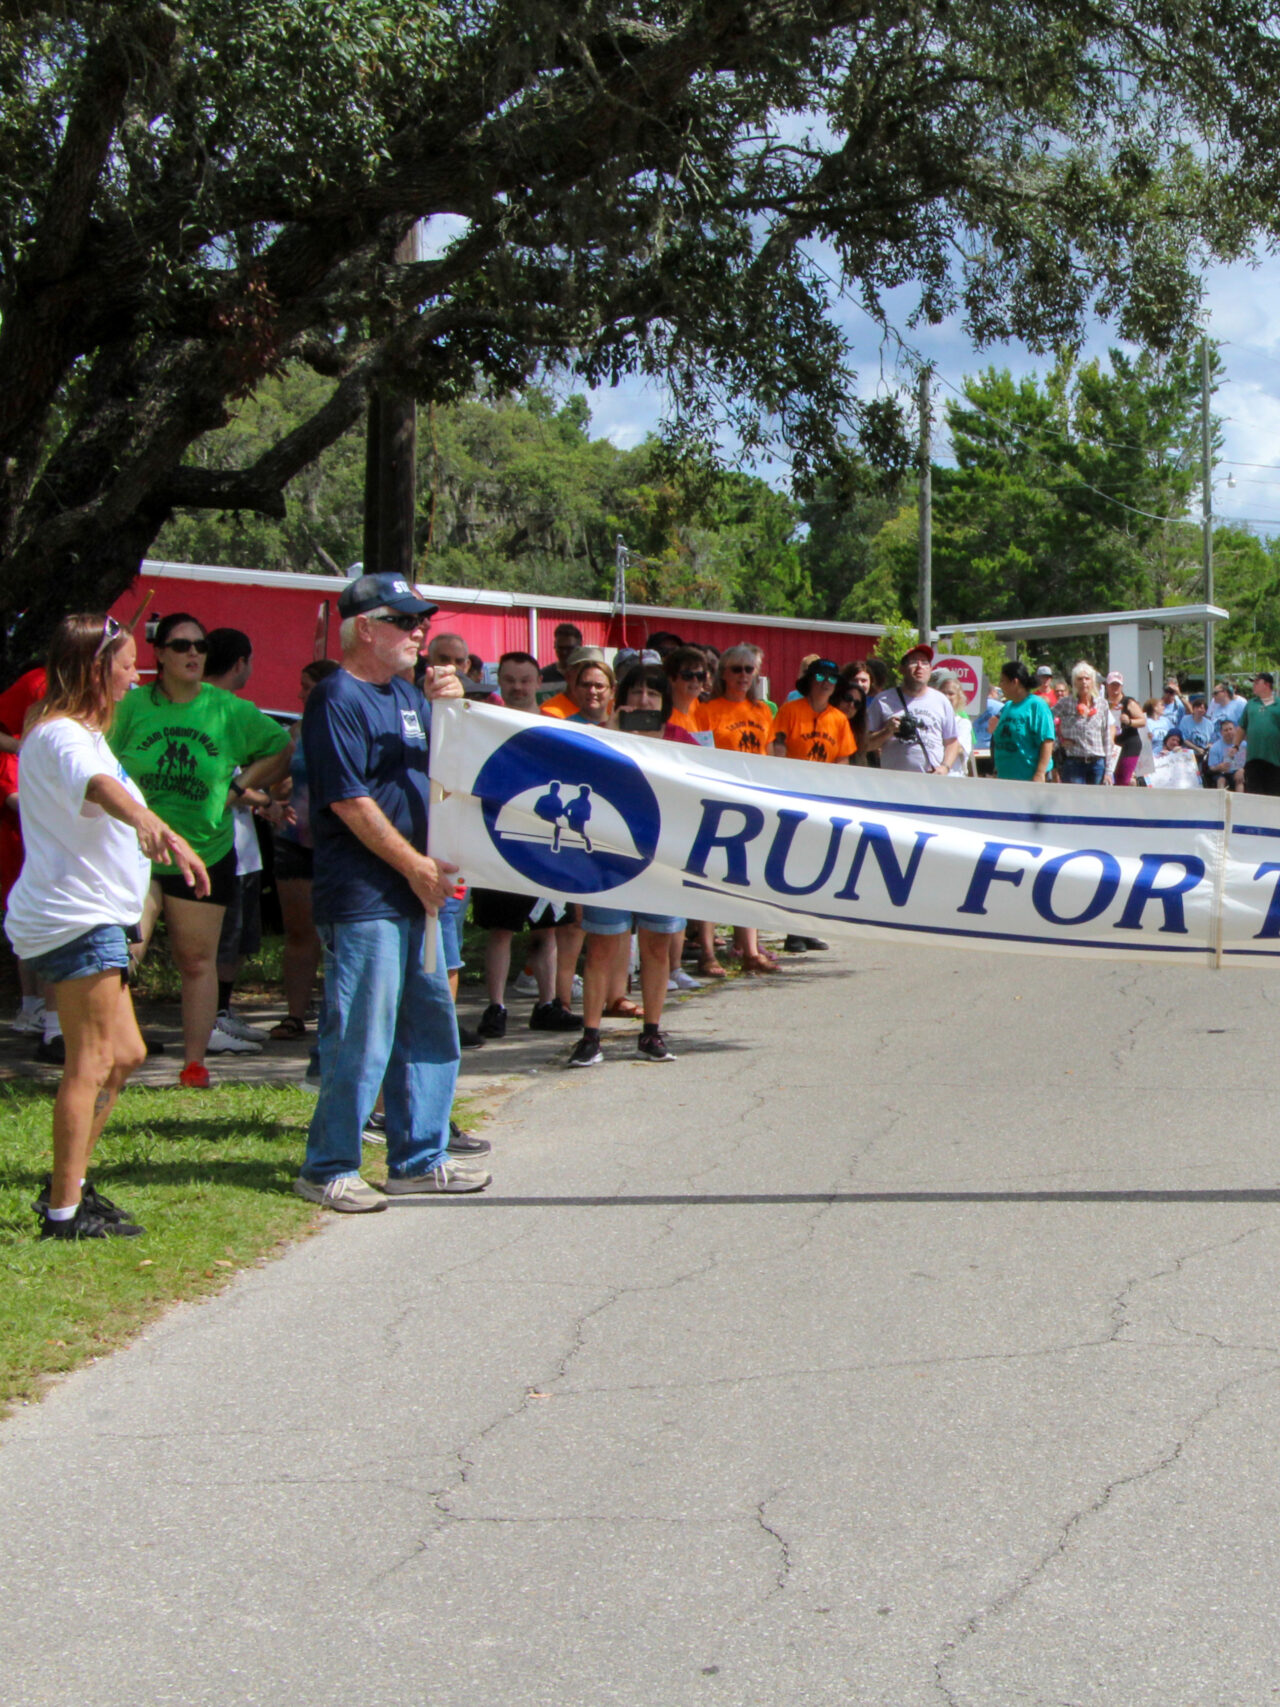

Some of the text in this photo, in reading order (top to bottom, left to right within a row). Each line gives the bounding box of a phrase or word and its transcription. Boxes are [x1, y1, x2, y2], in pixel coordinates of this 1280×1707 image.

[136, 731, 163, 751] Team
[685, 799, 937, 908] RUN
[956, 841, 1205, 935] FOR
